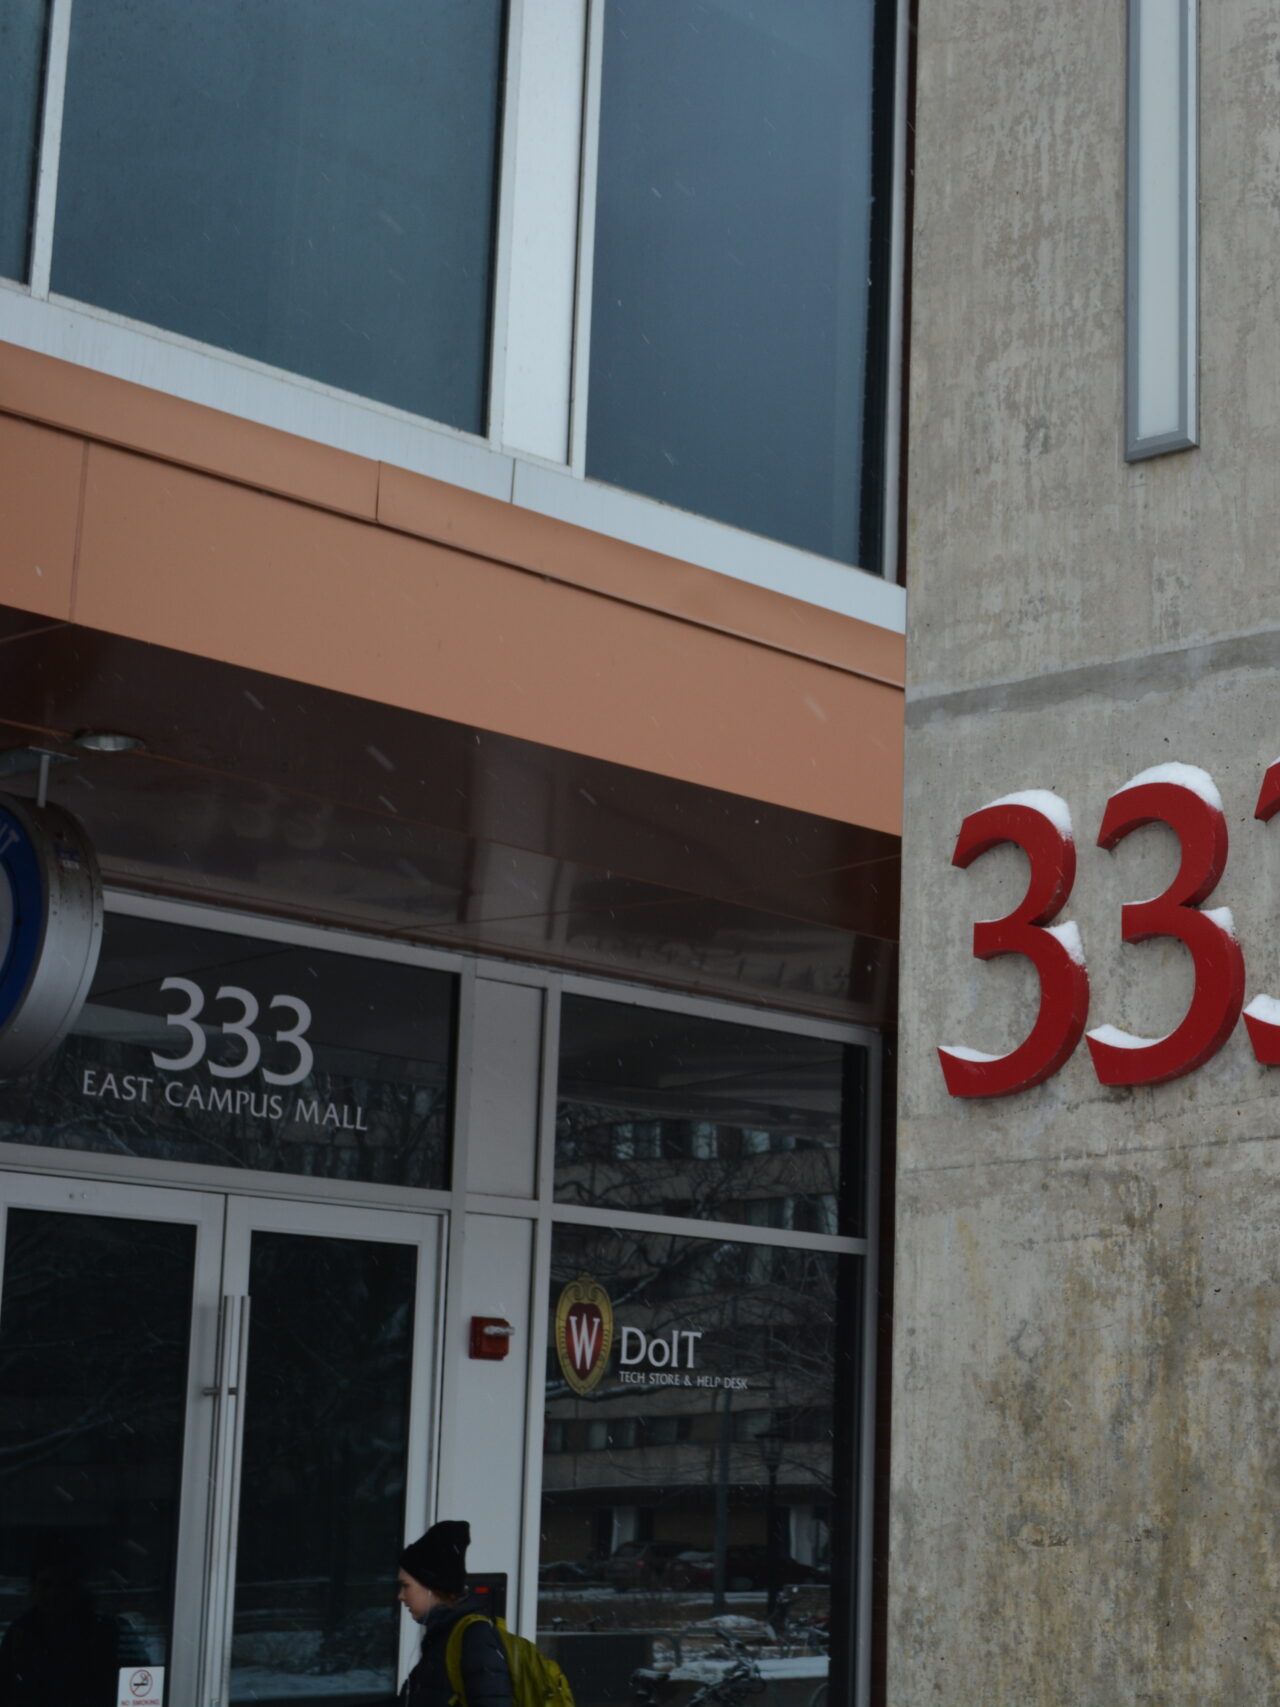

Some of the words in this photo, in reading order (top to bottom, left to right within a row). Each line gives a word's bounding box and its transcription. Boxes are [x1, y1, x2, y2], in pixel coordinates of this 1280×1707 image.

[151, 976, 314, 1086] 333
[82, 1069, 154, 1103] EAST
[165, 1081, 283, 1120] CAMPUS
[295, 1098, 368, 1132] MALL
[569, 1312, 601, 1371] W
[620, 1326, 702, 1369] DoIT
[619, 1370, 646, 1384] TECH
[649, 1373, 681, 1386] STORE
[683, 1374, 693, 1386] &
[696, 1375, 721, 1388] HELP
[723, 1377, 748, 1390] DESK
